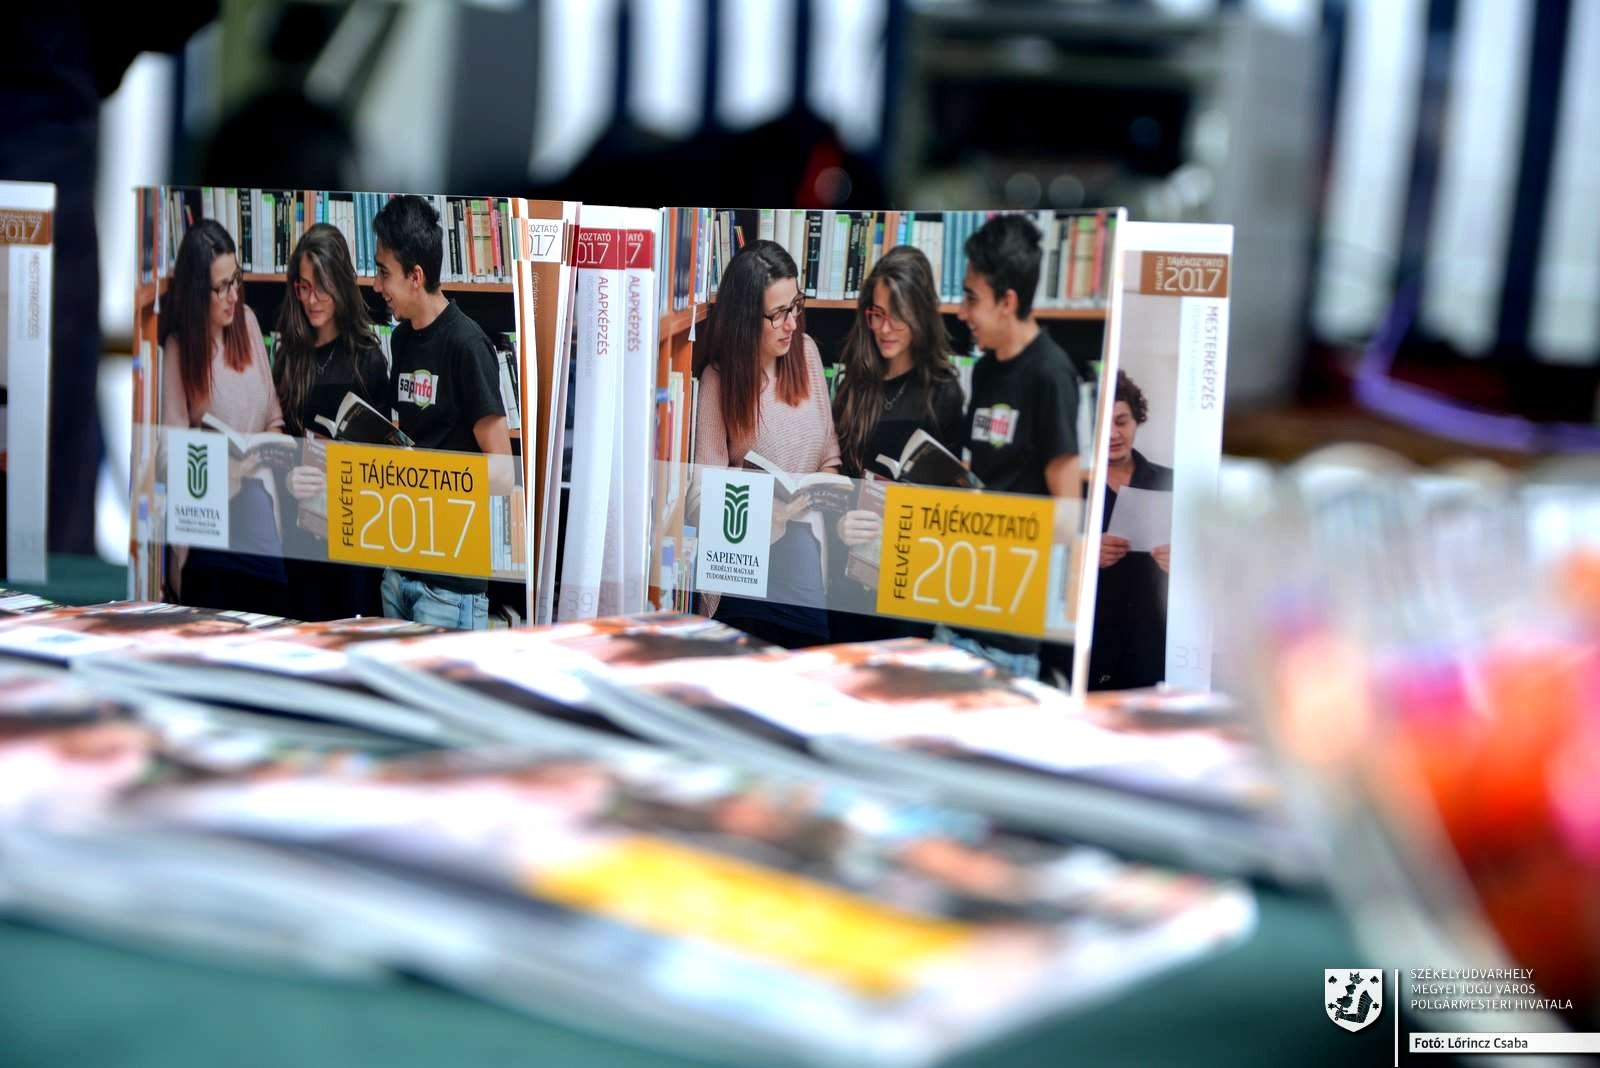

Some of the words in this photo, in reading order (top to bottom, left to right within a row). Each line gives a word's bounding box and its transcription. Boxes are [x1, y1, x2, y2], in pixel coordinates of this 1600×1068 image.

[597, 276, 610, 356] ALAPKÉPZÉS
[627, 276, 642, 353] ALAPKÉPZÉS
[1164, 267, 1221, 292] 2017
[1201, 305, 1218, 410] MESTERKÉPZÉS
[174, 503, 221, 521] SAPIENTIA
[340, 461, 354, 547] FELVÉTELI
[359, 458, 474, 493] TÁJÉKOZTATÓ
[359, 489, 476, 559] 2017
[894, 504, 913, 600] FELVÉTELI
[921, 503, 1040, 540] TÁJÉKOZTATÓ
[706, 550, 760, 568] SAPIENTIA
[912, 537, 1040, 615] 2017
